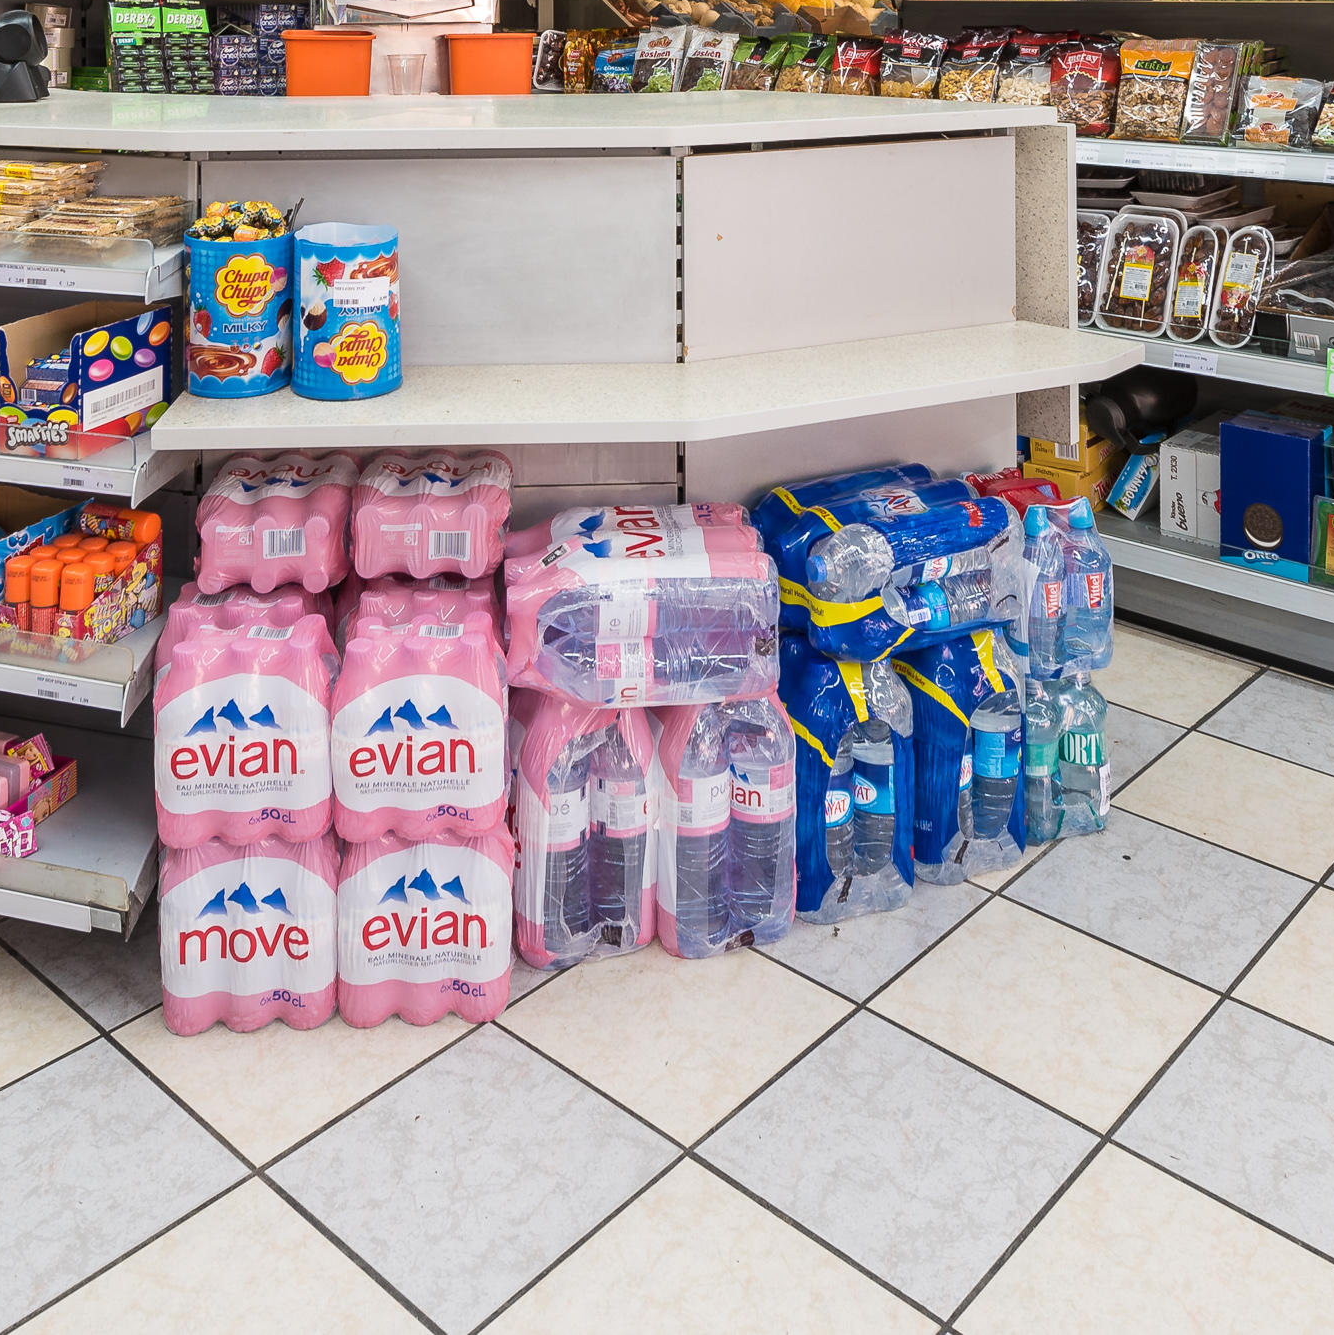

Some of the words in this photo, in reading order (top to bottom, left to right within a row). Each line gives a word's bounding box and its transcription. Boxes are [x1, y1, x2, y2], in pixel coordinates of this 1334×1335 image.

[116, 13, 147, 24] DERBY
[167, 12, 200, 24] DERBY
[1067, 53, 1099, 66] meray
[1137, 59, 1170, 71] KEREM
[224, 269, 271, 285] Chupa
[221, 283, 268, 307] Chups
[223, 321, 268, 334] MILKY
[339, 330, 383, 351] Chups
[337, 352, 382, 369] Chupa
[1121, 462, 1149, 507] BOUNTY
[1175, 492, 1188, 532] bueno
[1244, 549, 1281, 563] OREO
[1046, 582, 1060, 617] Vittel
[1088, 574, 1103, 609] Vittel
[170, 735, 298, 780] evian
[349, 734, 477, 778] evian
[176, 783, 192, 792] EAU
[193, 781, 240, 791] MINERALE
[241, 779, 294, 789] NATURELLE
[354, 781, 370, 790] EAU
[371, 780, 418, 790] MINERALE
[419, 778, 472, 788] NATURELLE
[730, 787, 765, 809] ian
[361, 907, 487, 953] evian
[178, 923, 310, 966] move
[367, 954, 386, 964] EAU
[386, 952, 433, 963] MINERALE
[434, 952, 483, 962] NATURELLE
